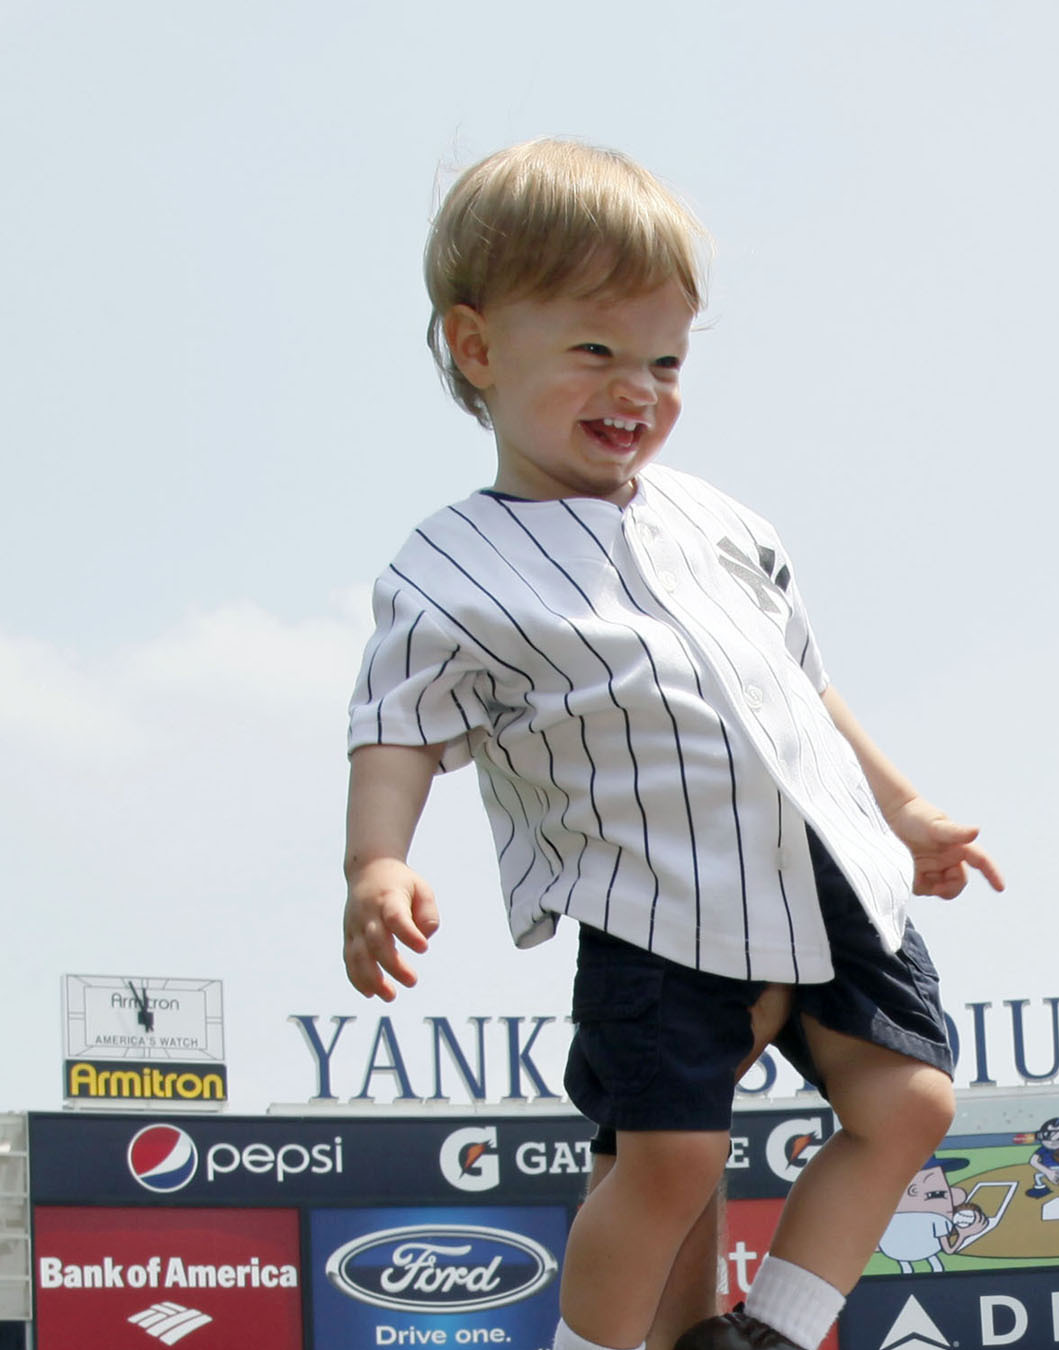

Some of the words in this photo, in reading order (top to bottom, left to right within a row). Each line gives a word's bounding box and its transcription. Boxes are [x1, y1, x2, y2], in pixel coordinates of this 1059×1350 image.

[111, 992, 180, 1010] Armron
[95, 1035, 156, 1047] AMERICA'S
[160, 1037, 198, 1048] WATCH
[287, 1014, 564, 1101] YANK
[70, 1063, 224, 1099] Armitron
[206, 1136, 344, 1182] pepsi
[40, 1256, 123, 1288] Bank
[127, 1255, 162, 1288] of
[166, 1256, 298, 1289] America
[381, 1242, 503, 1294] Ford
[375, 1325, 447, 1346] Drive
[455, 1328, 512, 1344] one.
